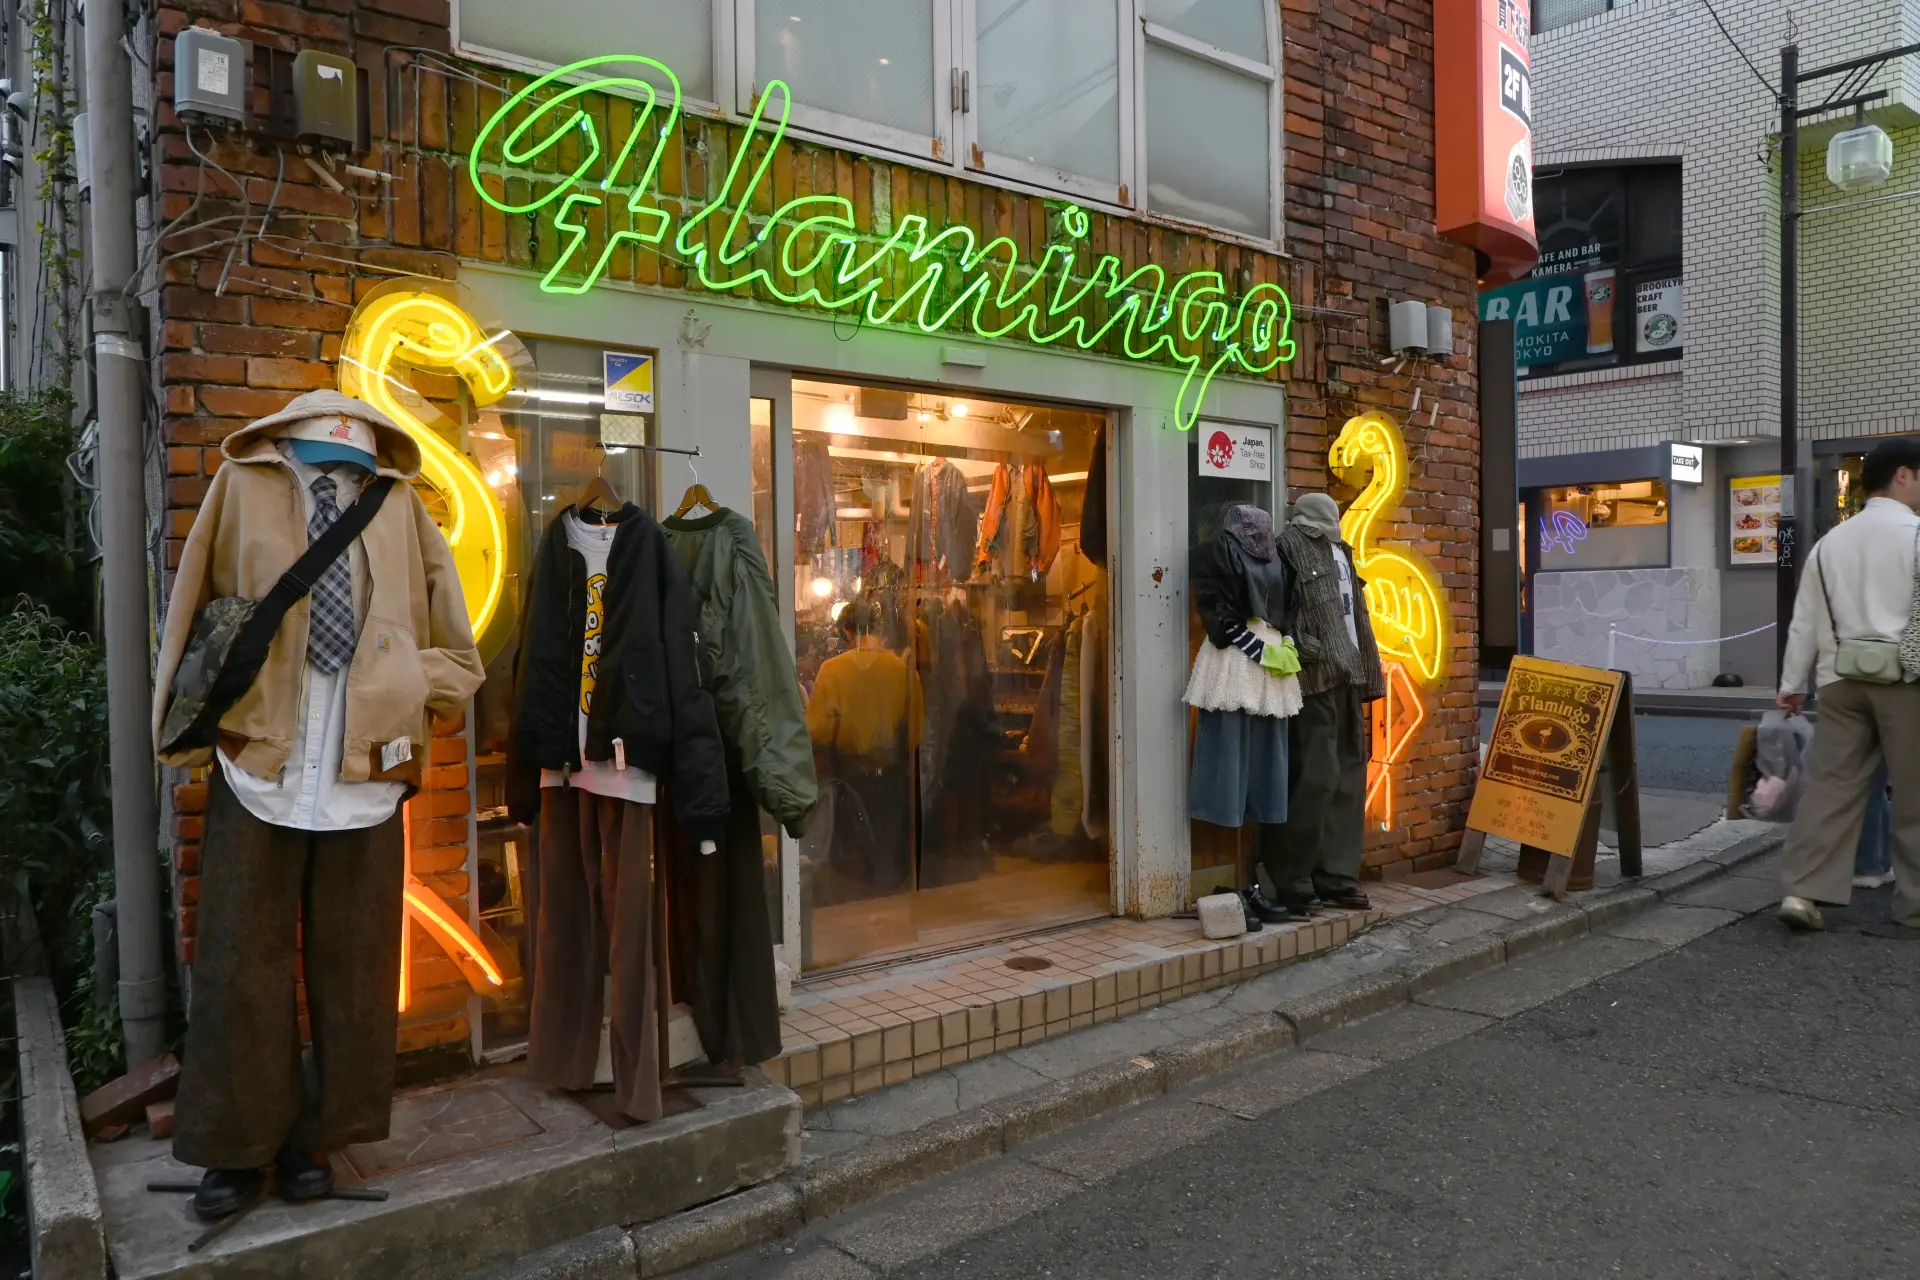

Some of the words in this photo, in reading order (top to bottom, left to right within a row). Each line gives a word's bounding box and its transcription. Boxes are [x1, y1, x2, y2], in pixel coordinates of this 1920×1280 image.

[1504, 63, 1521, 102] 2F
[470, 54, 1296, 432] Flamingo
[1537, 251, 1556, 265] AFE
[1557, 247, 1579, 261] AND
[1581, 243, 1601, 256] BAR
[1531, 262, 1573, 279] KAMERA
[1485, 285, 1573, 327] BAR
[1637, 292, 1663, 304] CRAFT
[1637, 304, 1658, 314] BEER
[1516, 331, 1570, 348] MOKITA
[1240, 448, 1266, 459] Tax-free
[1673, 457, 1685, 465] TAKE
[1685, 458, 1695, 466] OUT
[1249, 459, 1266, 471] Shop
[1518, 695, 1591, 724] Flamingo
